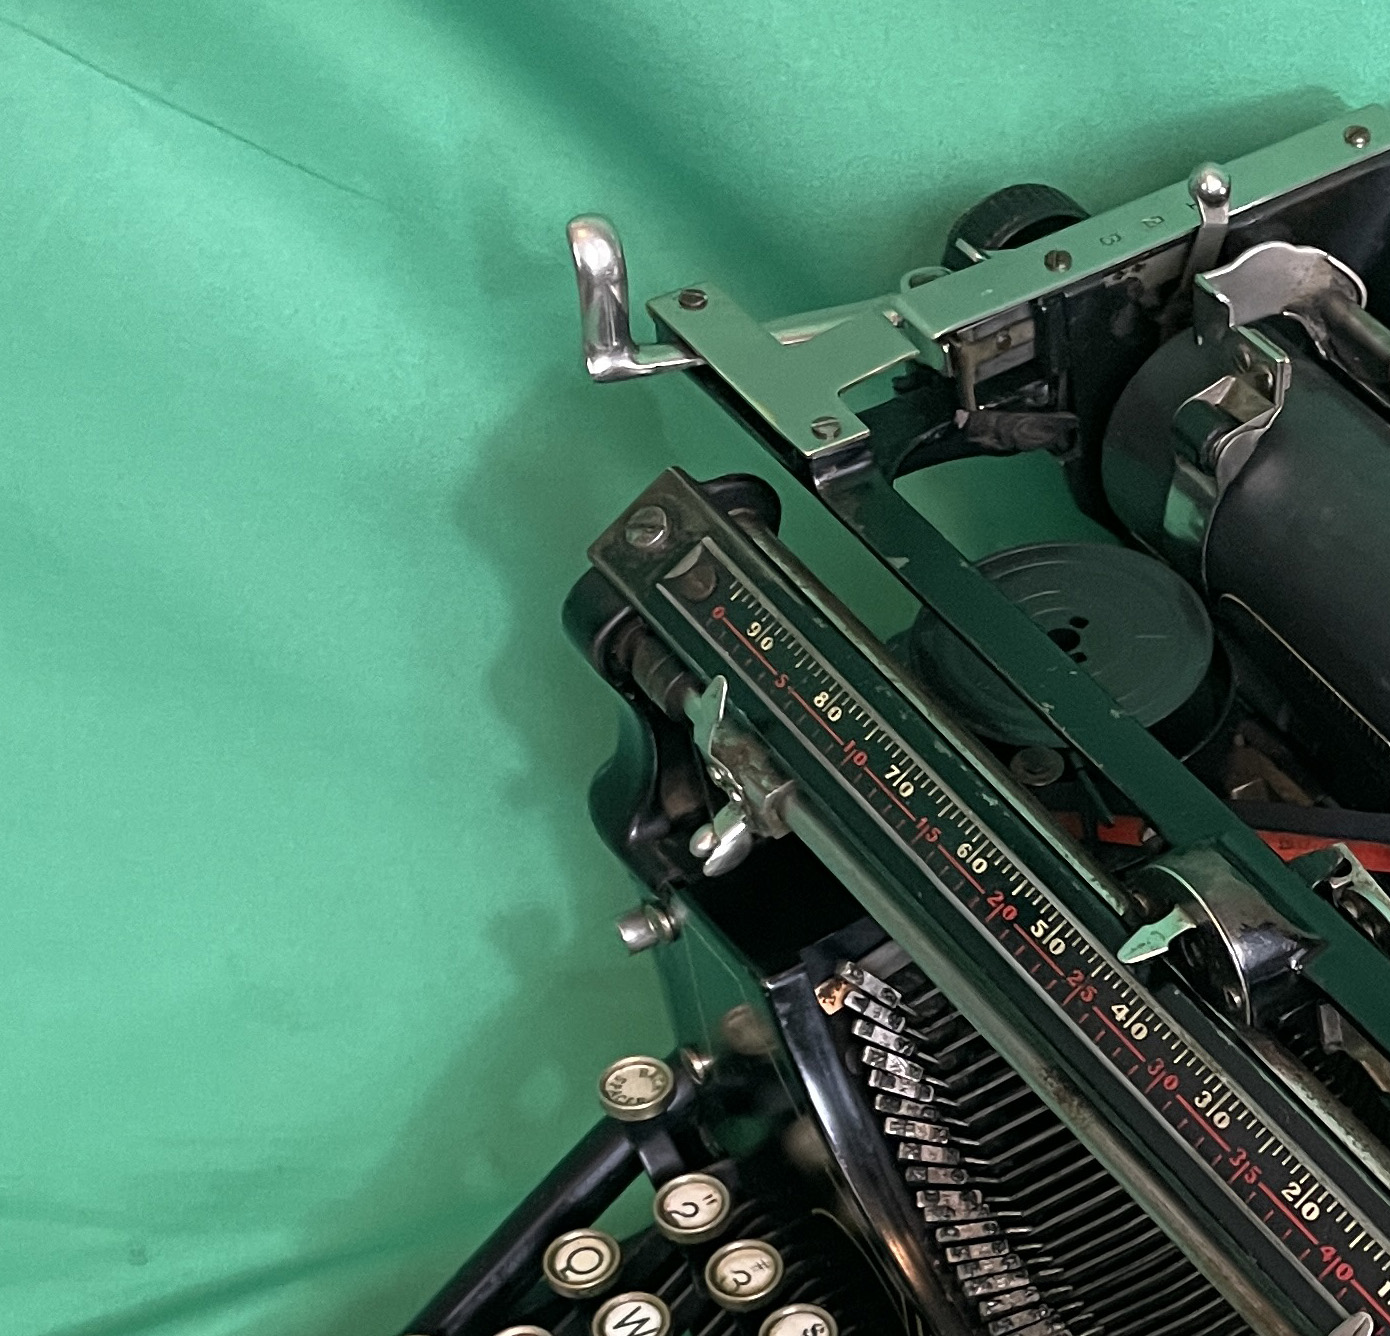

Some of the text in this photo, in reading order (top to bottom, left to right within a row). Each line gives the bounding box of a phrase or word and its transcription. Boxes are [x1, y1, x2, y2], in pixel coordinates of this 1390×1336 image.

[746, 621, 775, 651] 90
[813, 691, 843, 722] 80
[884, 764, 915, 798] 70
[956, 843, 988, 874] 60
[1030, 919, 1066, 956] 50
[1110, 1003, 1148, 1040] 40
[1194, 1090, 1231, 1129] 30
[1281, 1181, 1320, 1221] 20
[774, 673, 790, 688] 5
[843, 739, 868, 767] 10
[916, 817, 942, 843] 15
[986, 890, 1018, 921] 20
[1066, 969, 1098, 1003] 25
[1147, 1057, 1179, 1091] 30
[1229, 1148, 1262, 1185] 35
[1320, 1245, 1354, 1281] 40
[558, 1246, 604, 1281] Q
[665, 1201, 699, 1226] 2
